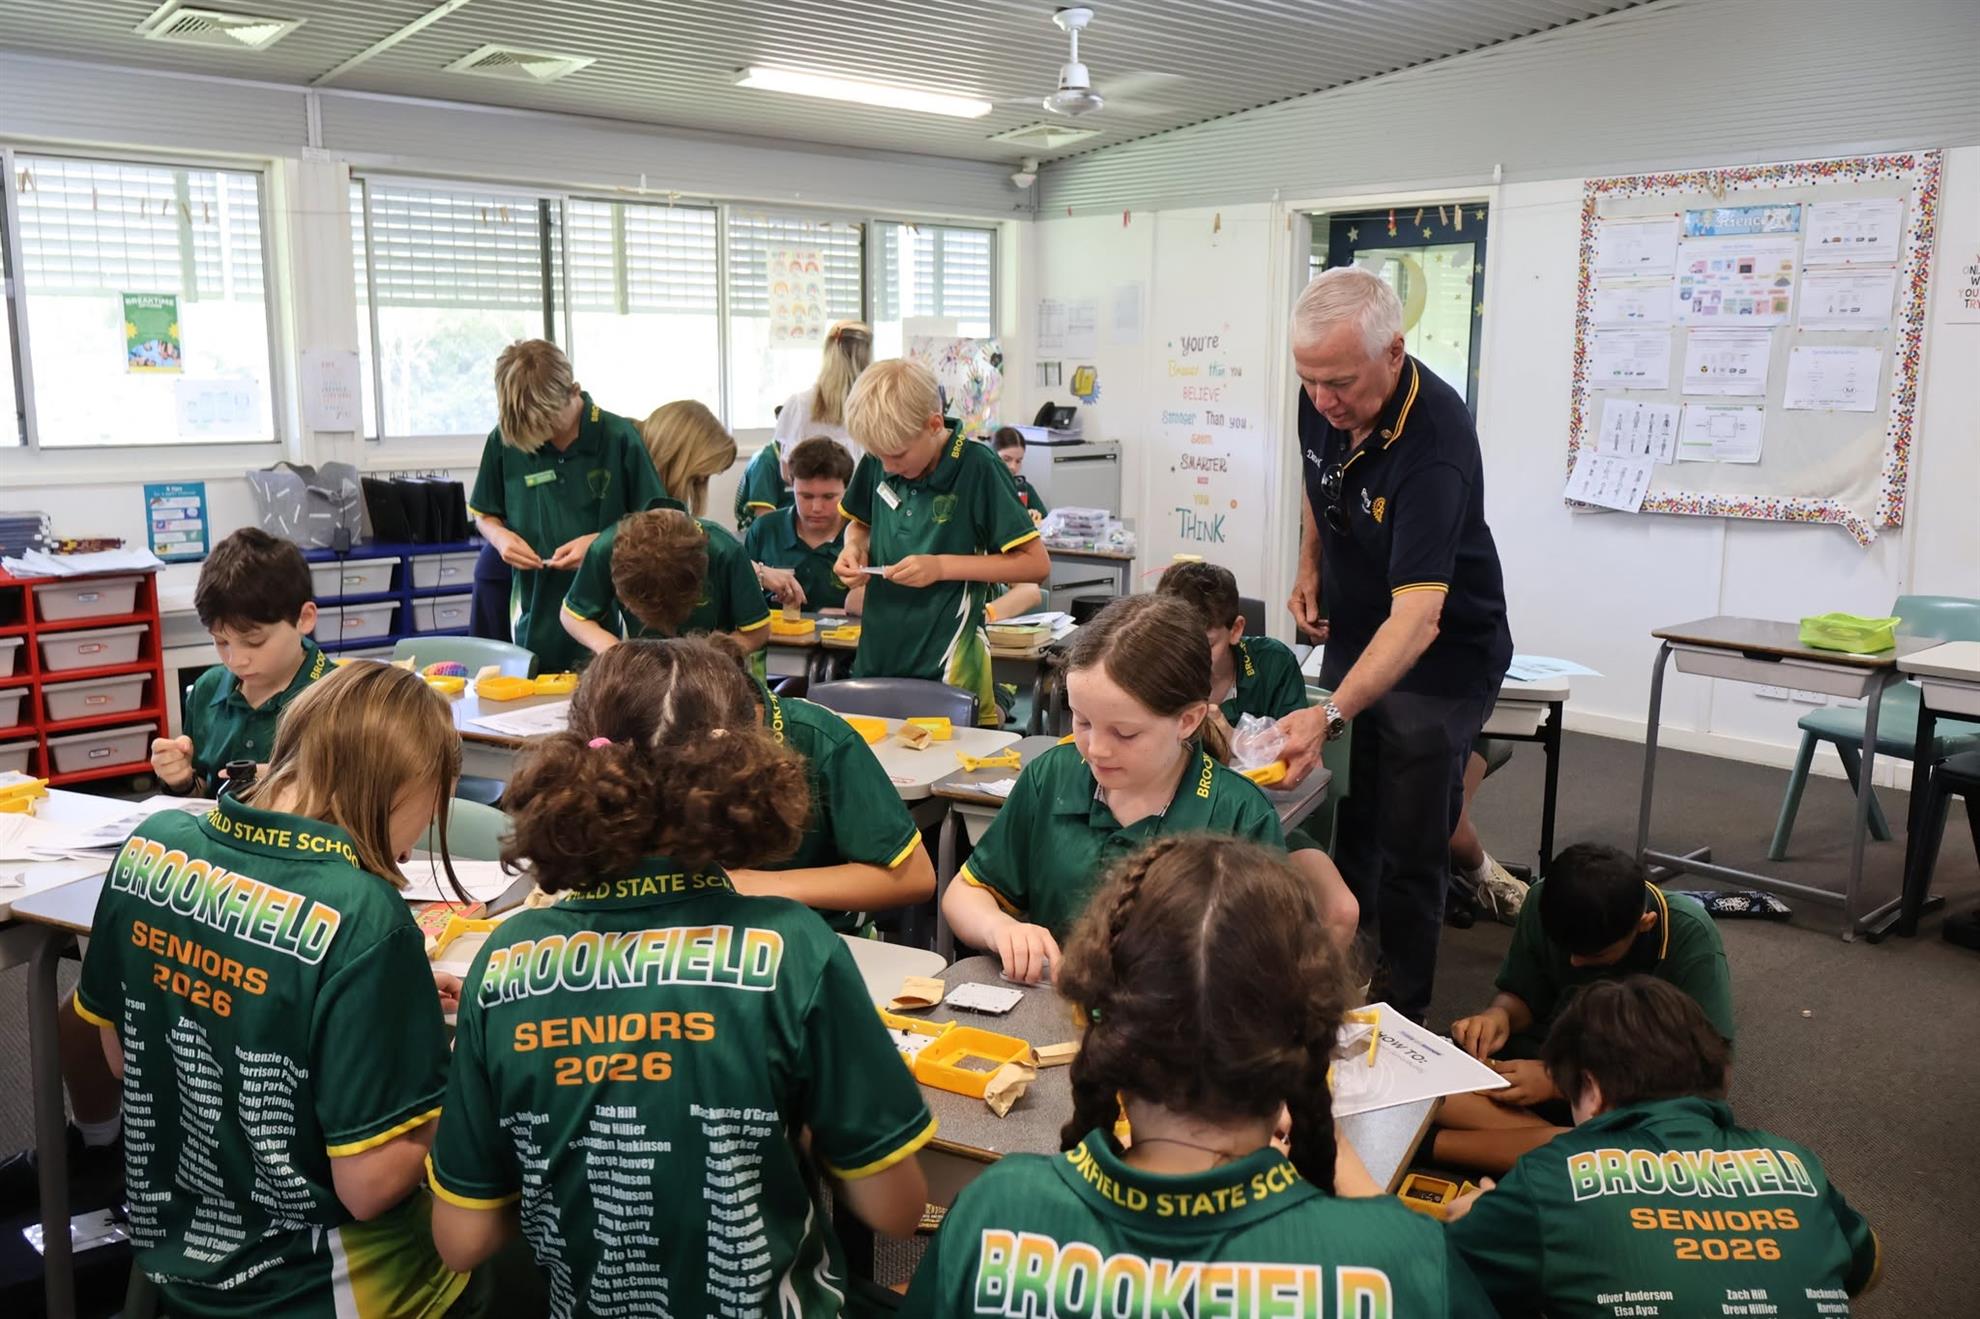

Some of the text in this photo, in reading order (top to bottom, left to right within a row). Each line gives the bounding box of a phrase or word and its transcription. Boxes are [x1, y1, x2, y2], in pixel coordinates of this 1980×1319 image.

[1183, 385, 1220, 402] BELIEVE
[1180, 453, 1227, 472] SMARTER
[233, 821, 292, 848] STATE
[615, 873, 686, 898] STATE
[111, 836, 341, 965] BROOKFIELD
[131, 920, 269, 996] SENIORS
[477, 924, 784, 1008] BROOKFIELD
[153, 963, 232, 1018] 2026
[513, 1011, 715, 1052] SENIORS
[555, 1052, 672, 1085] 2026
[243, 1079, 261, 1092] Mia
[198, 1106, 222, 1121] Kelly
[617, 1106, 636, 1118] Hill
[261, 1124, 296, 1136] Russell
[612, 1123, 646, 1135] Hillier
[742, 1125, 772, 1137] Page
[616, 1139, 671, 1152] Jenkinson
[1567, 1149, 1818, 1201] BROOKFIELD
[281, 1189, 310, 1199] Swan
[1156, 1184, 1248, 1216] STATE
[625, 1205, 654, 1216] Kelly
[1630, 1207, 1800, 1231] SENIORS
[626, 1248, 646, 1259] Lau
[1673, 1238, 1781, 1260] 2026
[625, 1262, 660, 1273] Maher
[1597, 1290, 1673, 1304] Oliver Anderson
[1726, 1289, 1767, 1300] Zach Hill
[1614, 1305, 1659, 1317] Elsa Ayaz
[1722, 1304, 1777, 1315] Drew Hillier
